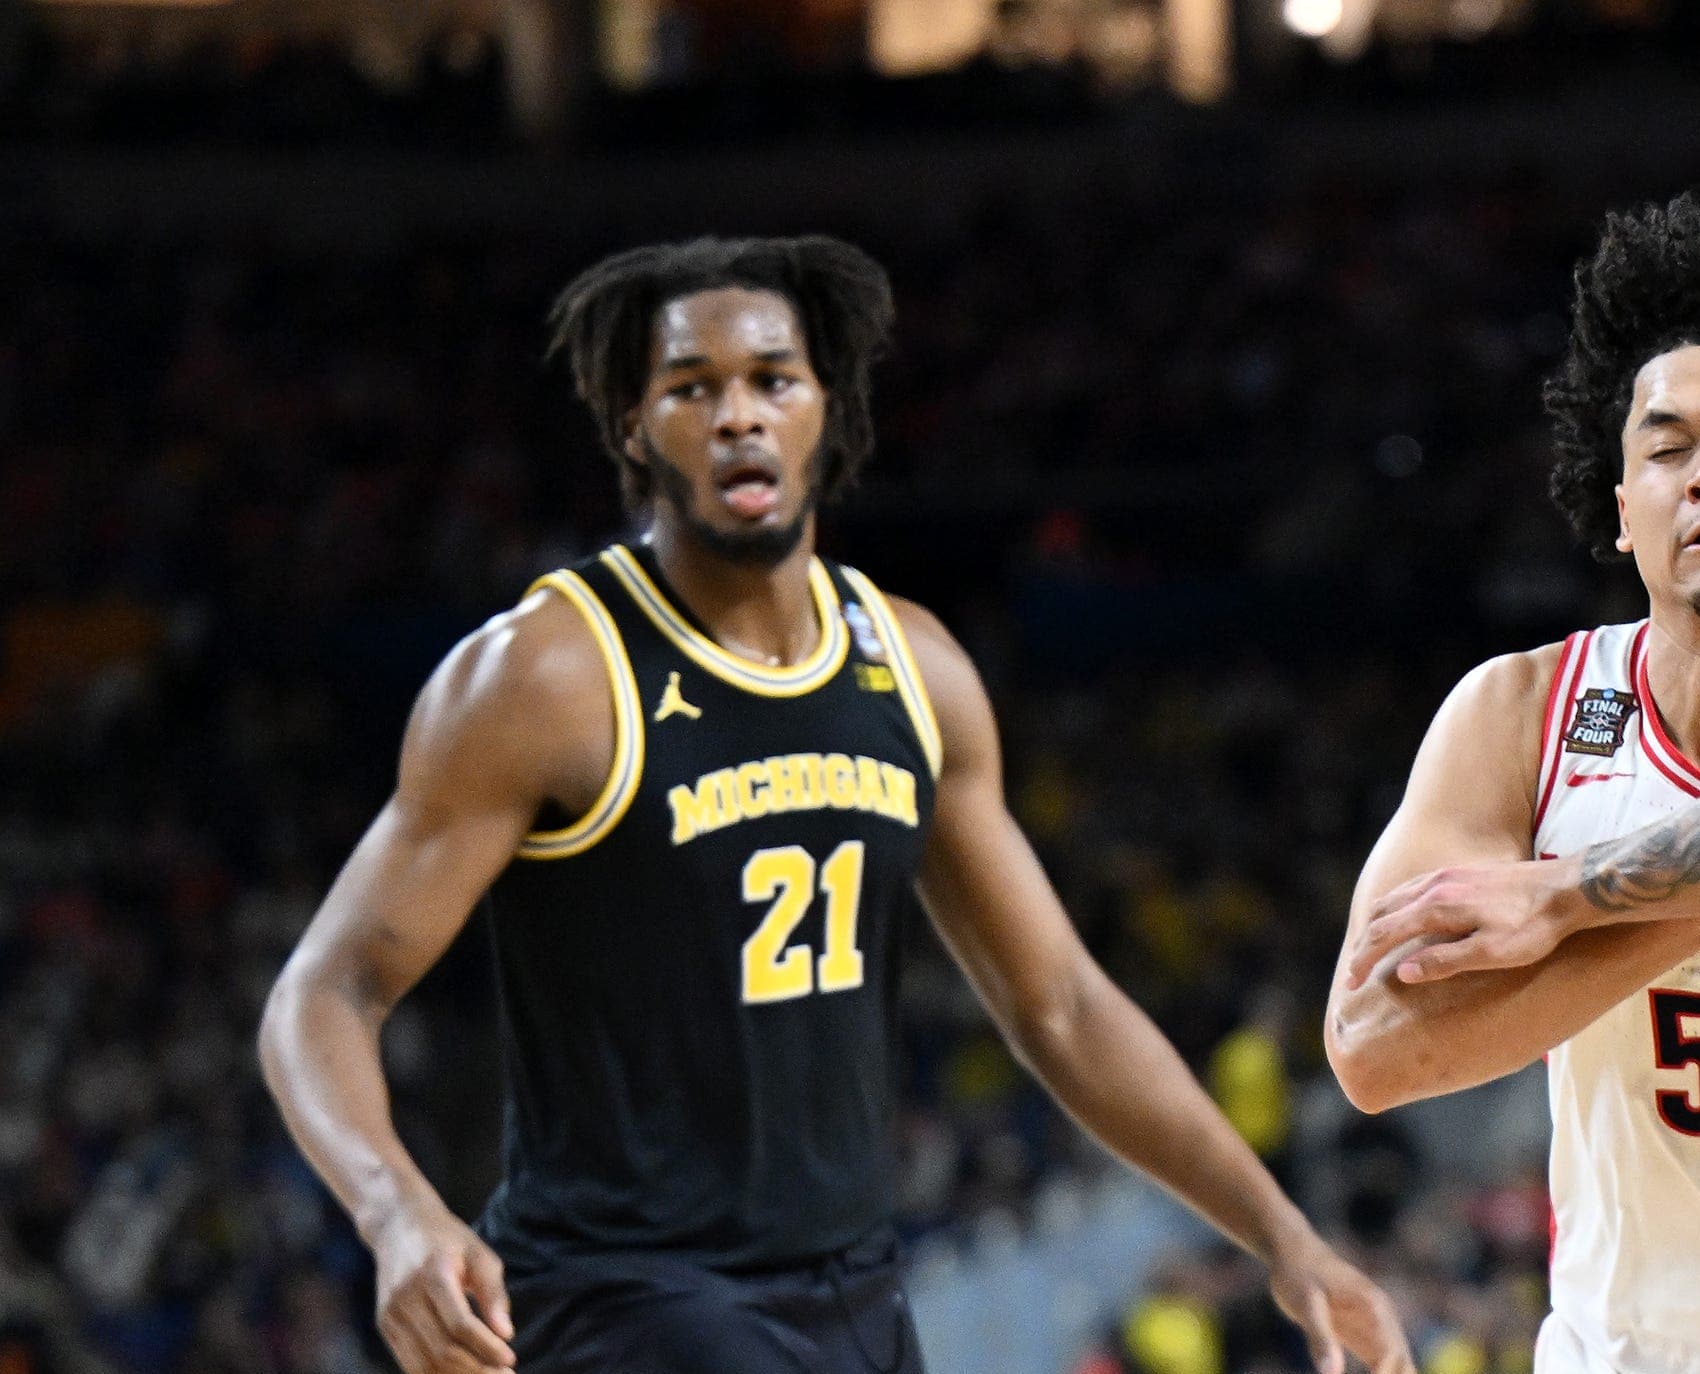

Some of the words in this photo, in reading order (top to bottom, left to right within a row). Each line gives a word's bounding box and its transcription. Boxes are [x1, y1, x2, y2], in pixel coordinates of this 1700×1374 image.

[1573, 727, 1615, 744] FOUR
[1583, 700, 1624, 717] FINAL
[668, 752, 919, 846] MICHIGAN
[742, 840, 865, 1005] 21
